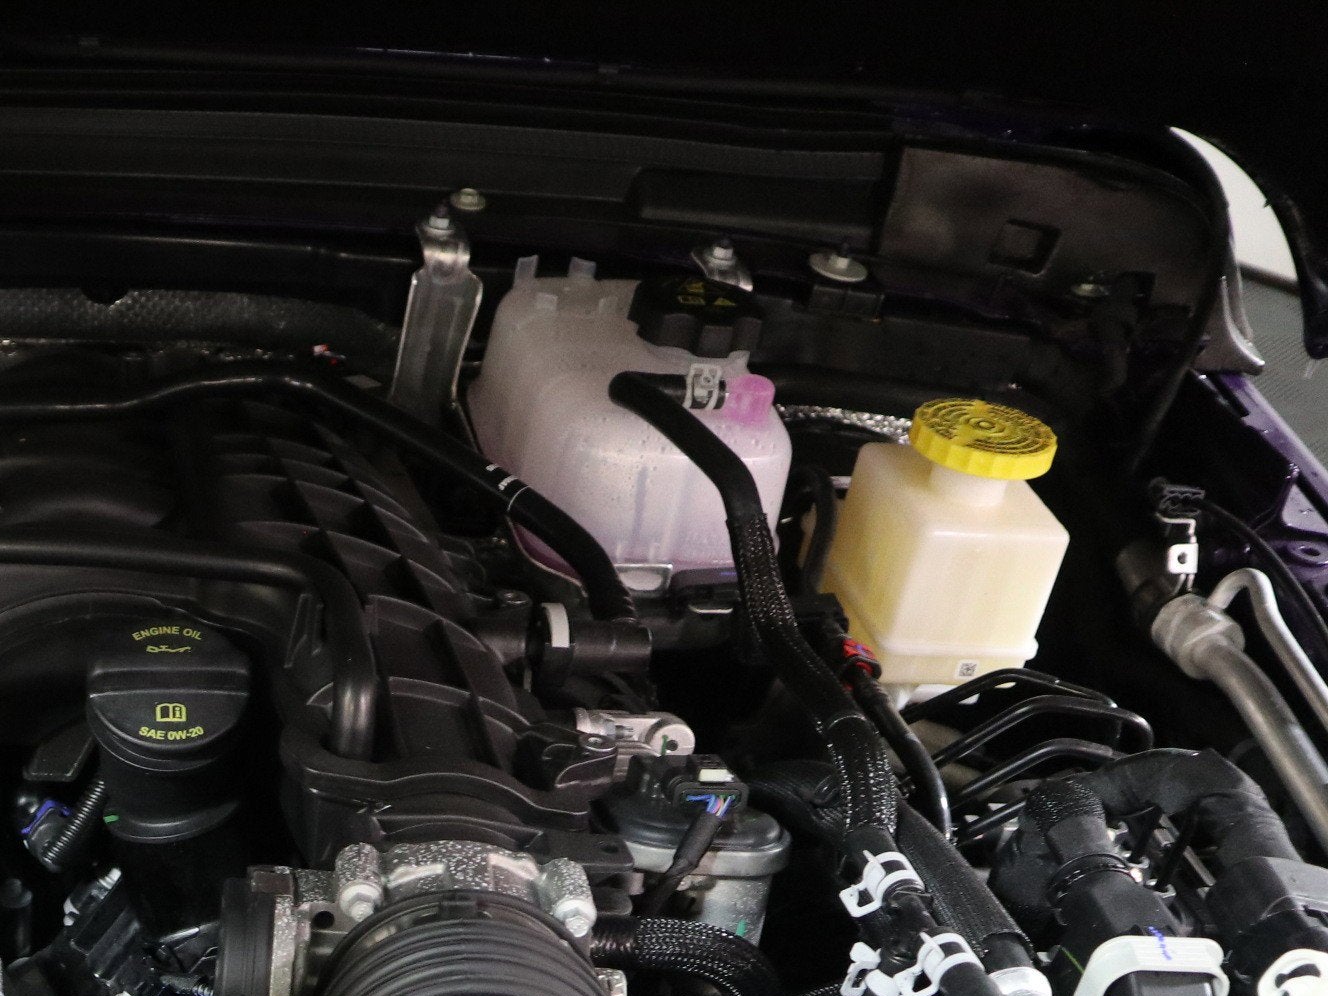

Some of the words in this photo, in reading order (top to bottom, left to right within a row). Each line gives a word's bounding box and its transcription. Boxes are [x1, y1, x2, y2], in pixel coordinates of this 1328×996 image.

[132, 626, 180, 641] ENGINE
[183, 628, 202, 640] OIL
[138, 726, 166, 740] SAE
[167, 726, 204, 741] 0W-20
